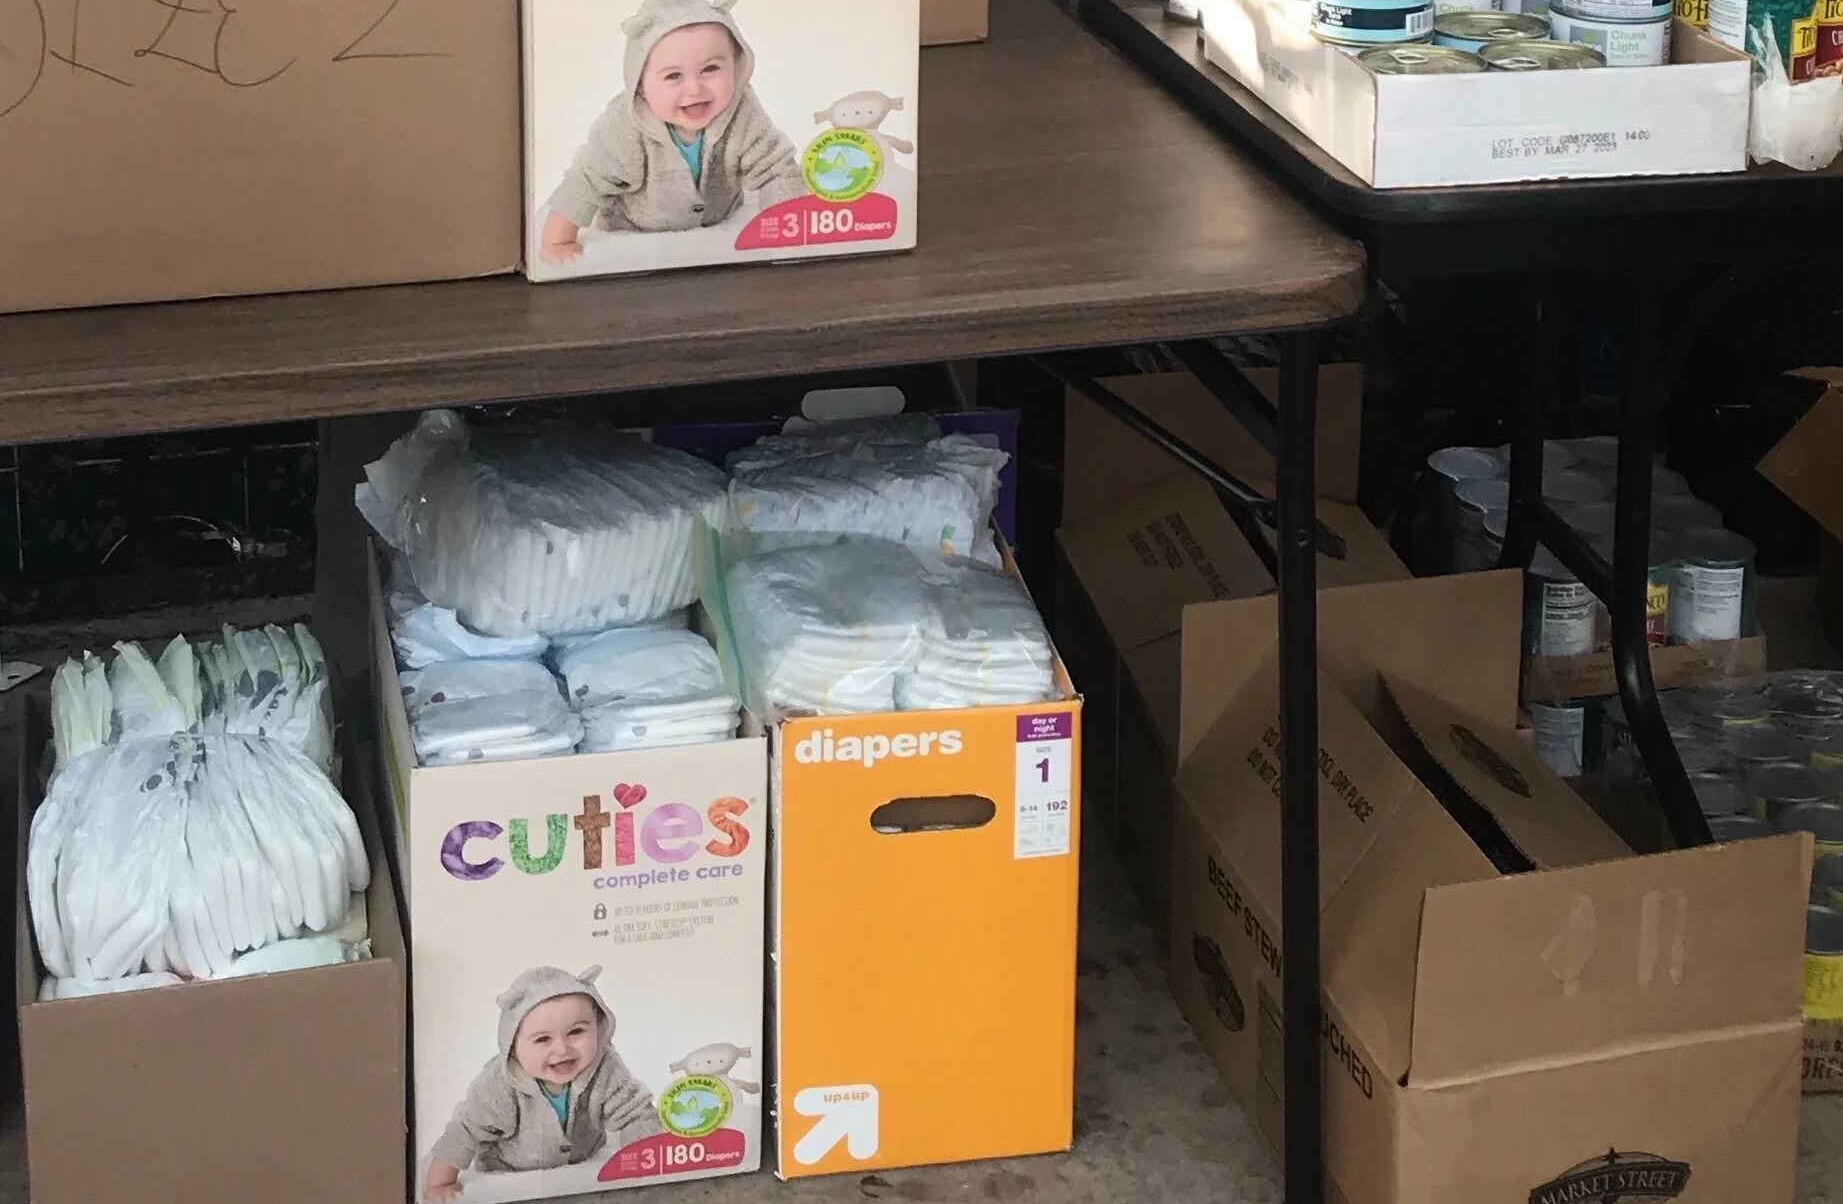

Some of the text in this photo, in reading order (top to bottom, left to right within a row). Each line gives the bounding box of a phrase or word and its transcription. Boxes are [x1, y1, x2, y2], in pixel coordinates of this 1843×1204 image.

[1610, 30, 1648, 41] Chunk
[1610, 41, 1640, 53] Light
[1492, 138, 1513, 149] LOT
[1521, 136, 1552, 147] CODE
[1492, 147, 1519, 159] BEST
[1524, 147, 1537, 157] BY
[1545, 145, 1569, 155] MAR
[782, 213, 799, 238] 3
[810, 208, 853, 235] 180
[854, 220, 892, 233] Diapers
[795, 728, 962, 768] diapers
[1036, 758, 1050, 783] 1
[1046, 800, 1068, 811] 192
[440, 782, 750, 881] cuties
[592, 863, 743, 890] complete care
[1208, 854, 1283, 979] BEEF STEW
[640, 1148, 656, 1170] 3
[666, 1143, 705, 1166] 180
[706, 1151, 740, 1162] Diapers
[1540, 1170, 1678, 1204] MARKET STREET
